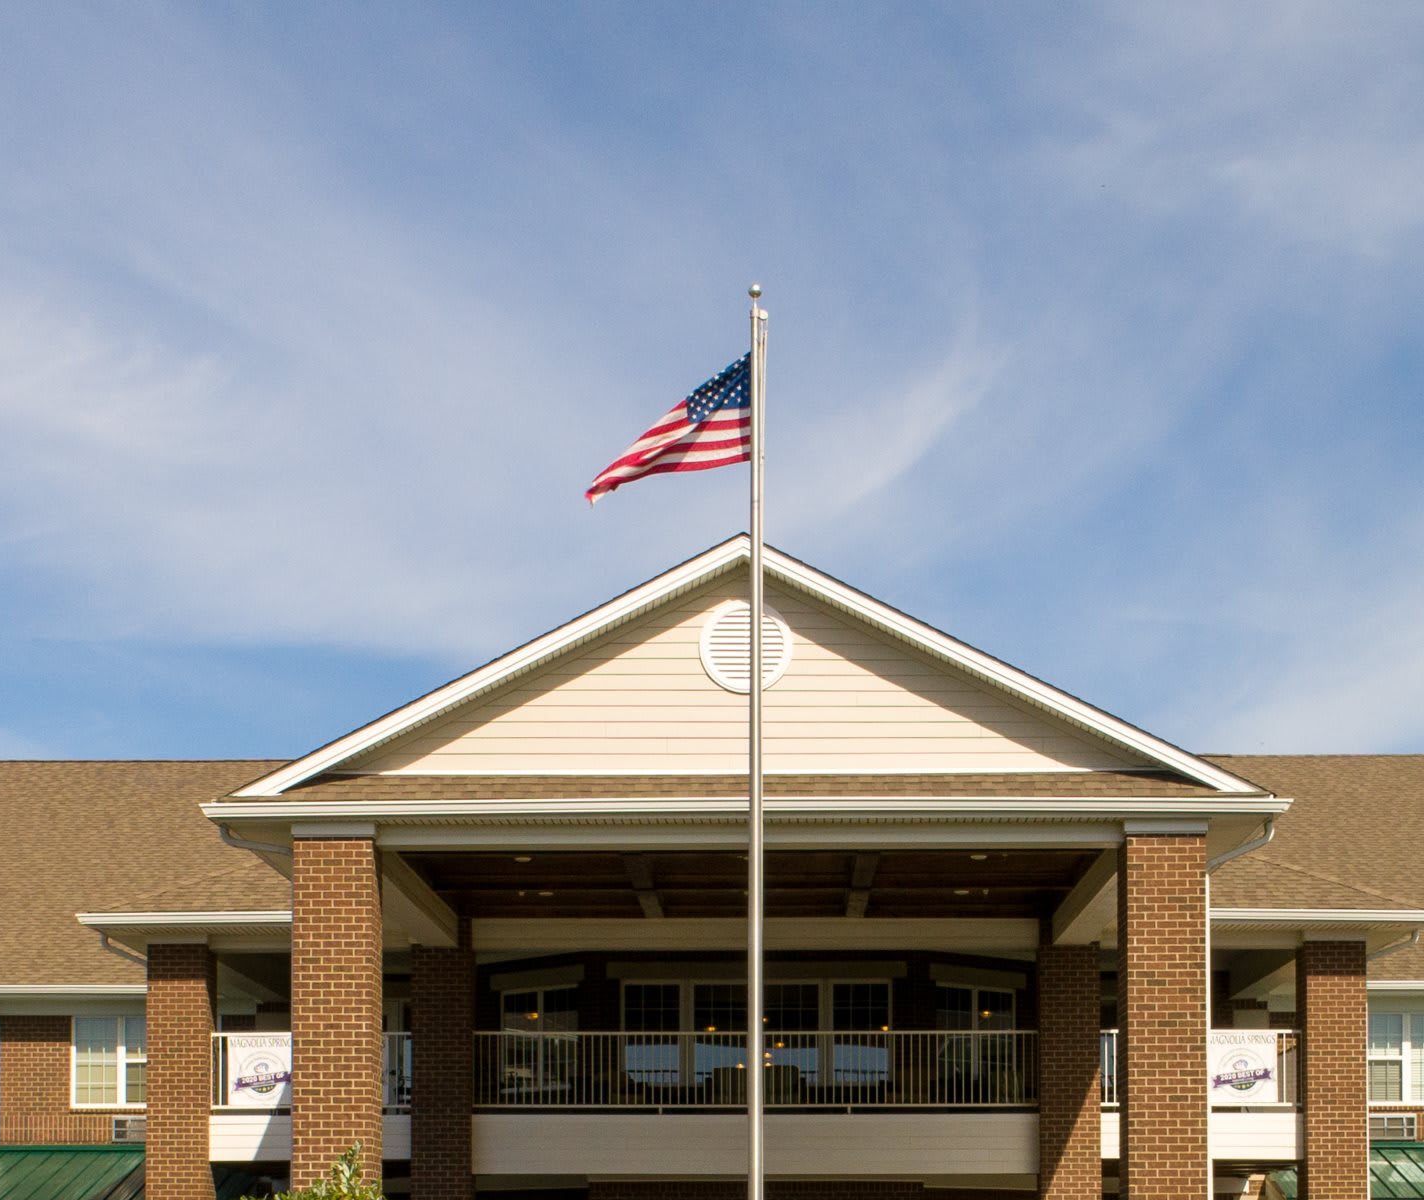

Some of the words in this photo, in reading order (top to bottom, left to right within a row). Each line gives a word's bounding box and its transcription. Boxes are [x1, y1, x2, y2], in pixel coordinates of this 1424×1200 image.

[230, 1038, 267, 1048] MAGNOLIA
[268, 1038, 291, 1048] SPRING
[1247, 1034, 1276, 1045] SPRINGS
[258, 1072, 275, 1082] BEST
